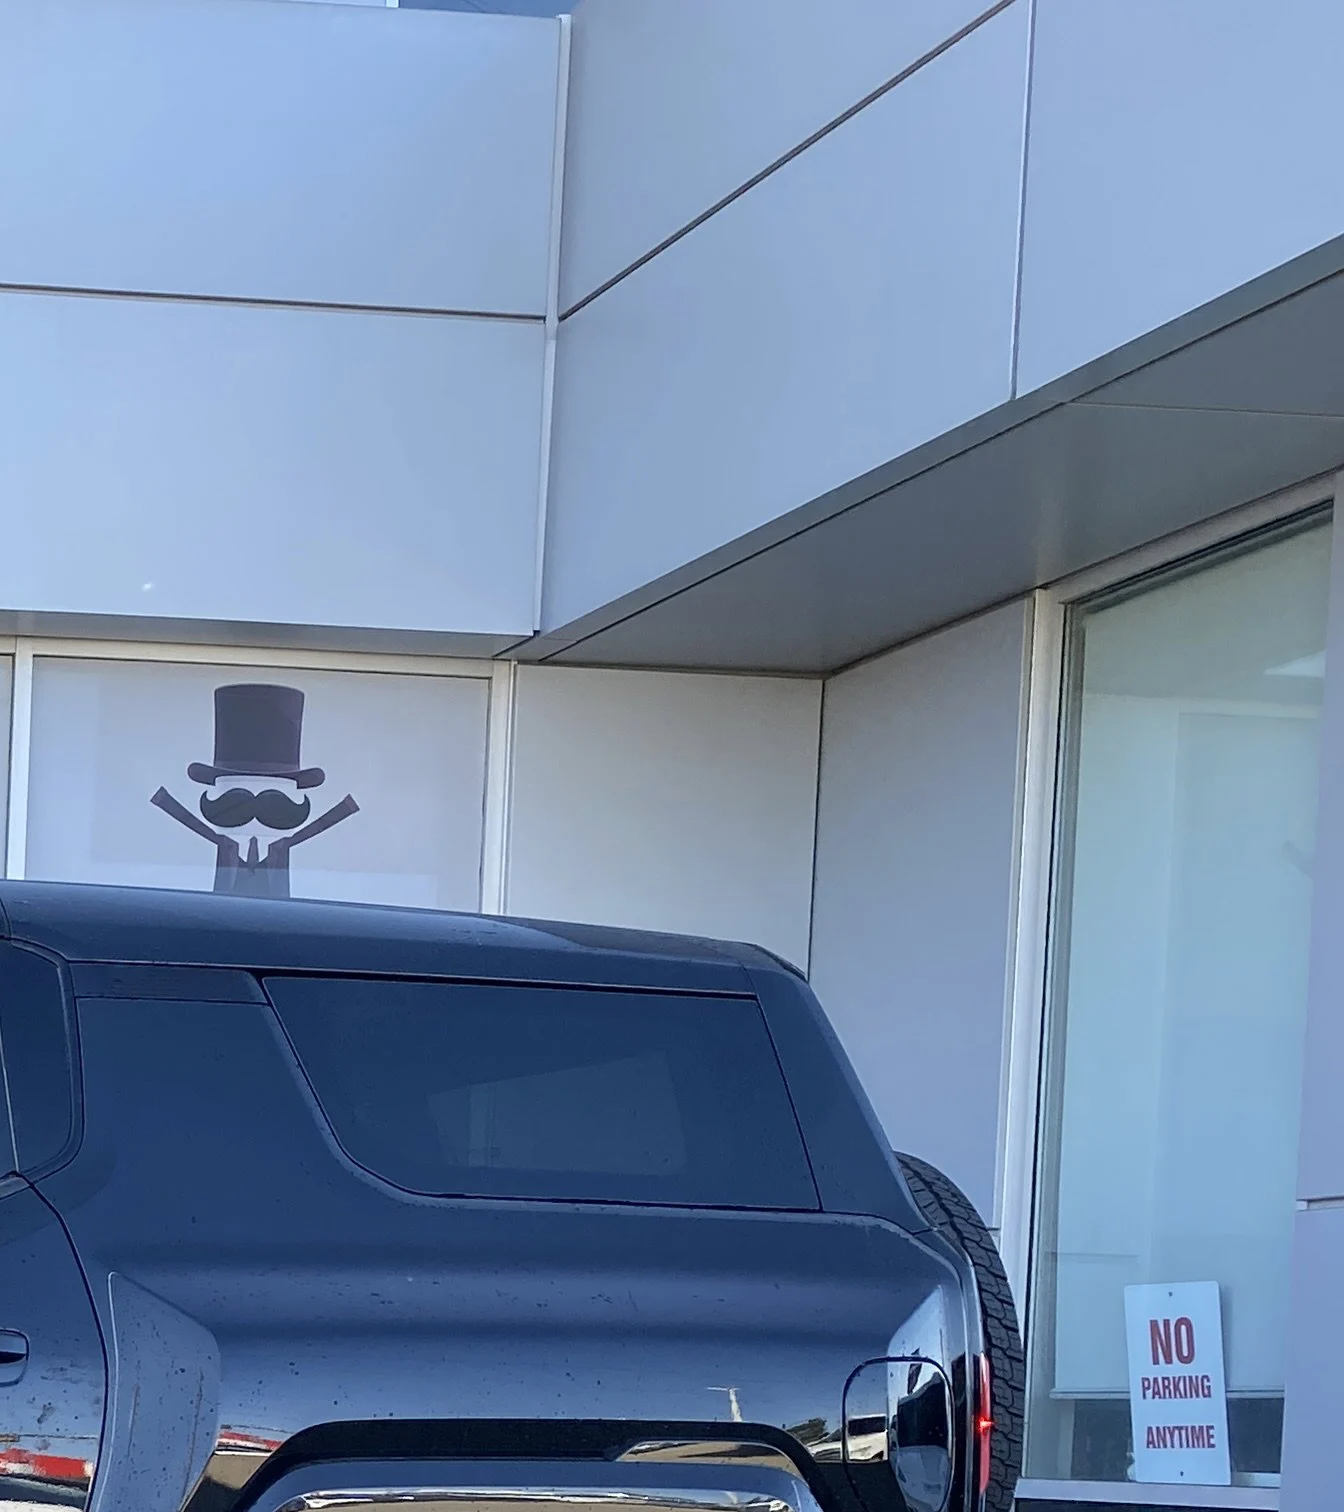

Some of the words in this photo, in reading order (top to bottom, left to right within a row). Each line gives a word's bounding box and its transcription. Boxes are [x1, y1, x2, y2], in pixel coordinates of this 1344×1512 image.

[1149, 1316, 1196, 1366] NO
[1141, 1374, 1212, 1400] PARKING
[1146, 1425, 1216, 1449] ANYTIME
